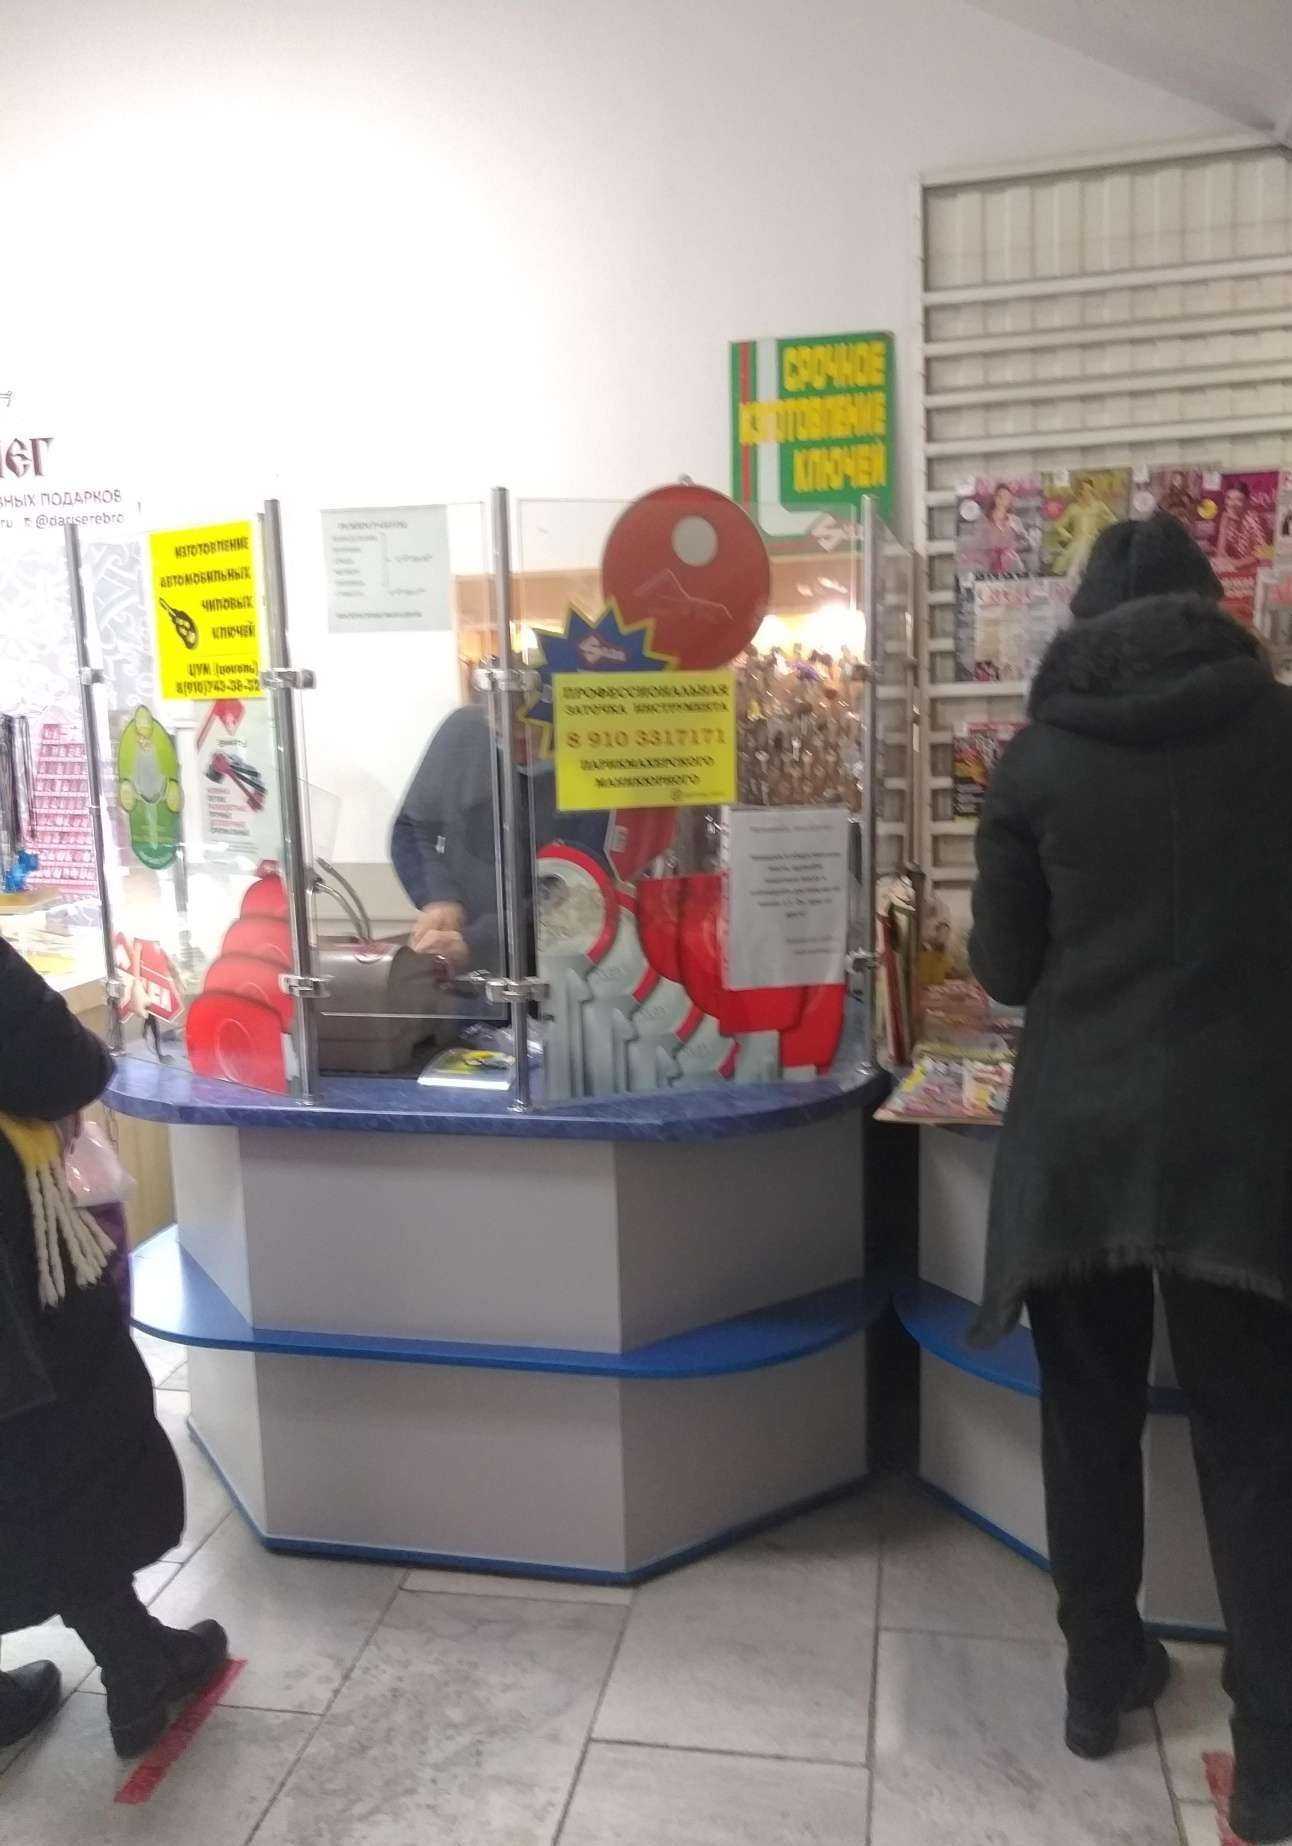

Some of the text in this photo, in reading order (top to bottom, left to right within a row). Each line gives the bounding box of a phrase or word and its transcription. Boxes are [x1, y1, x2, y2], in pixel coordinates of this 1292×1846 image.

[40, 488, 122, 507] ПОДАРКОВ
[175, 536, 249, 559] ИЗГОТОВЛЕНИЕ
[160, 566, 252, 588] АВТОМОБИЛЬНЫХ
[202, 595, 253, 612] ЧИПОВЫХ
[212, 621, 256, 640] КЛЮЧЕЙ
